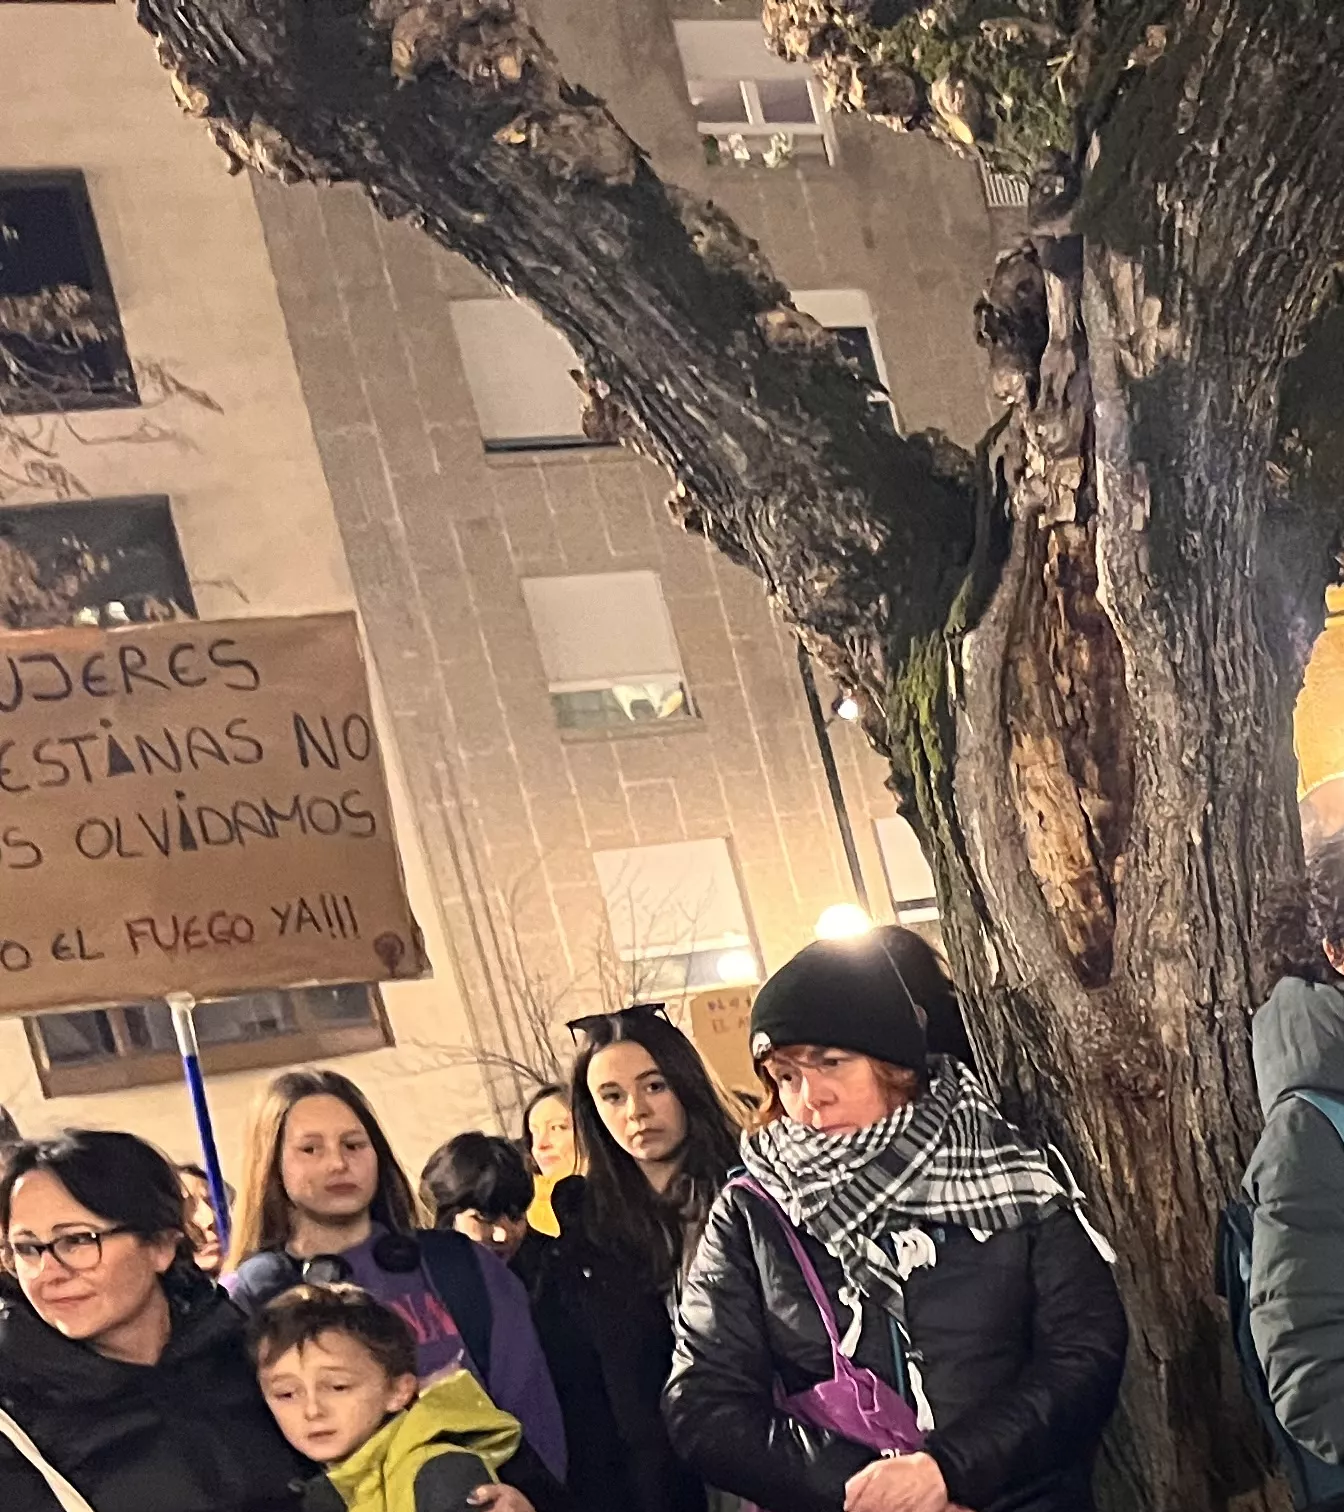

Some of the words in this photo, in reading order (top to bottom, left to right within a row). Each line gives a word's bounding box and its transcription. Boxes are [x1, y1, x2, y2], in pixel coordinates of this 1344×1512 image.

[294, 711, 371, 770] NO
[75, 790, 377, 860] OLVIDAMOS
[52, 926, 105, 961] EL
[126, 909, 255, 957] FUEGO
[271, 891, 359, 941] YA!!!
